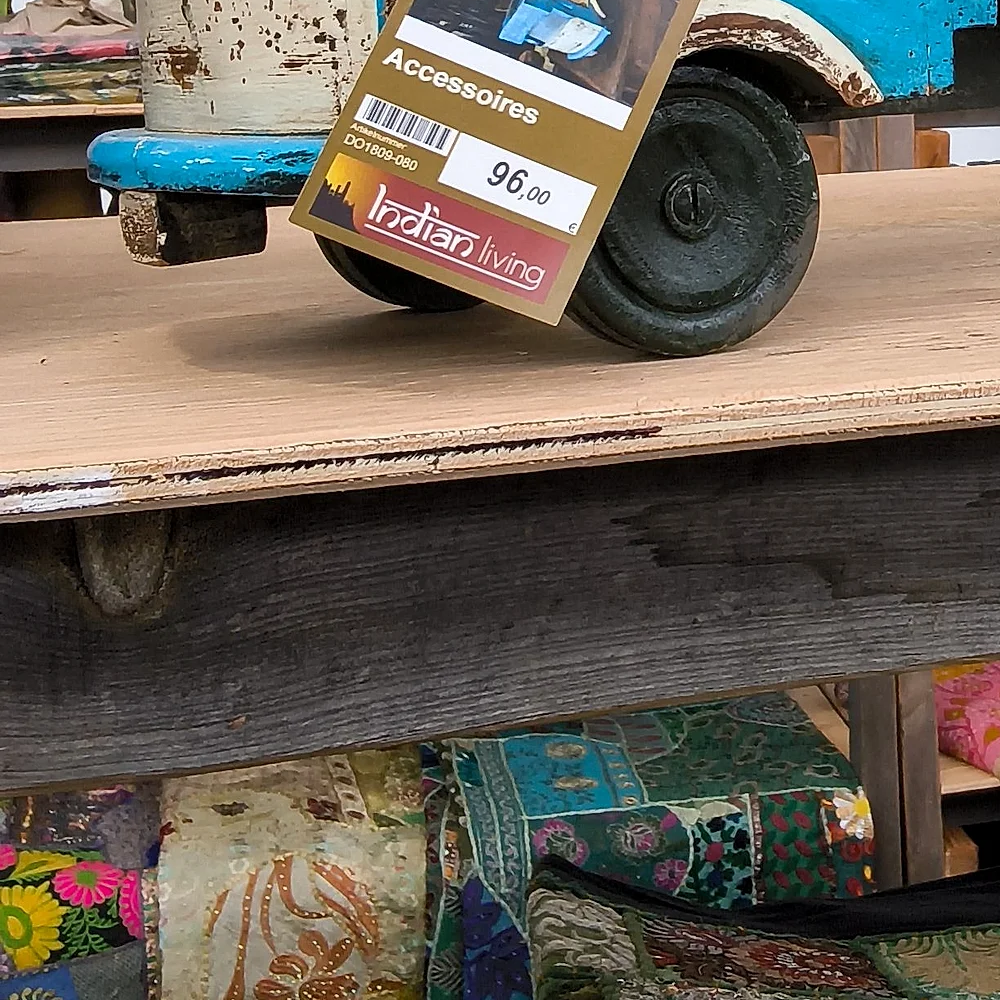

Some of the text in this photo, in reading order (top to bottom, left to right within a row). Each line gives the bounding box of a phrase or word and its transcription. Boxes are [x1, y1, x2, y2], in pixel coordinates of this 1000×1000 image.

[382, 47, 540, 125] Accessoires
[343, 133, 419, 171] DO1809-080
[350, 122, 408, 150] Artikelnummer
[486, 161, 551, 205] 96,00
[367, 183, 546, 291] Indian living
[568, 222, 578, 233] €
